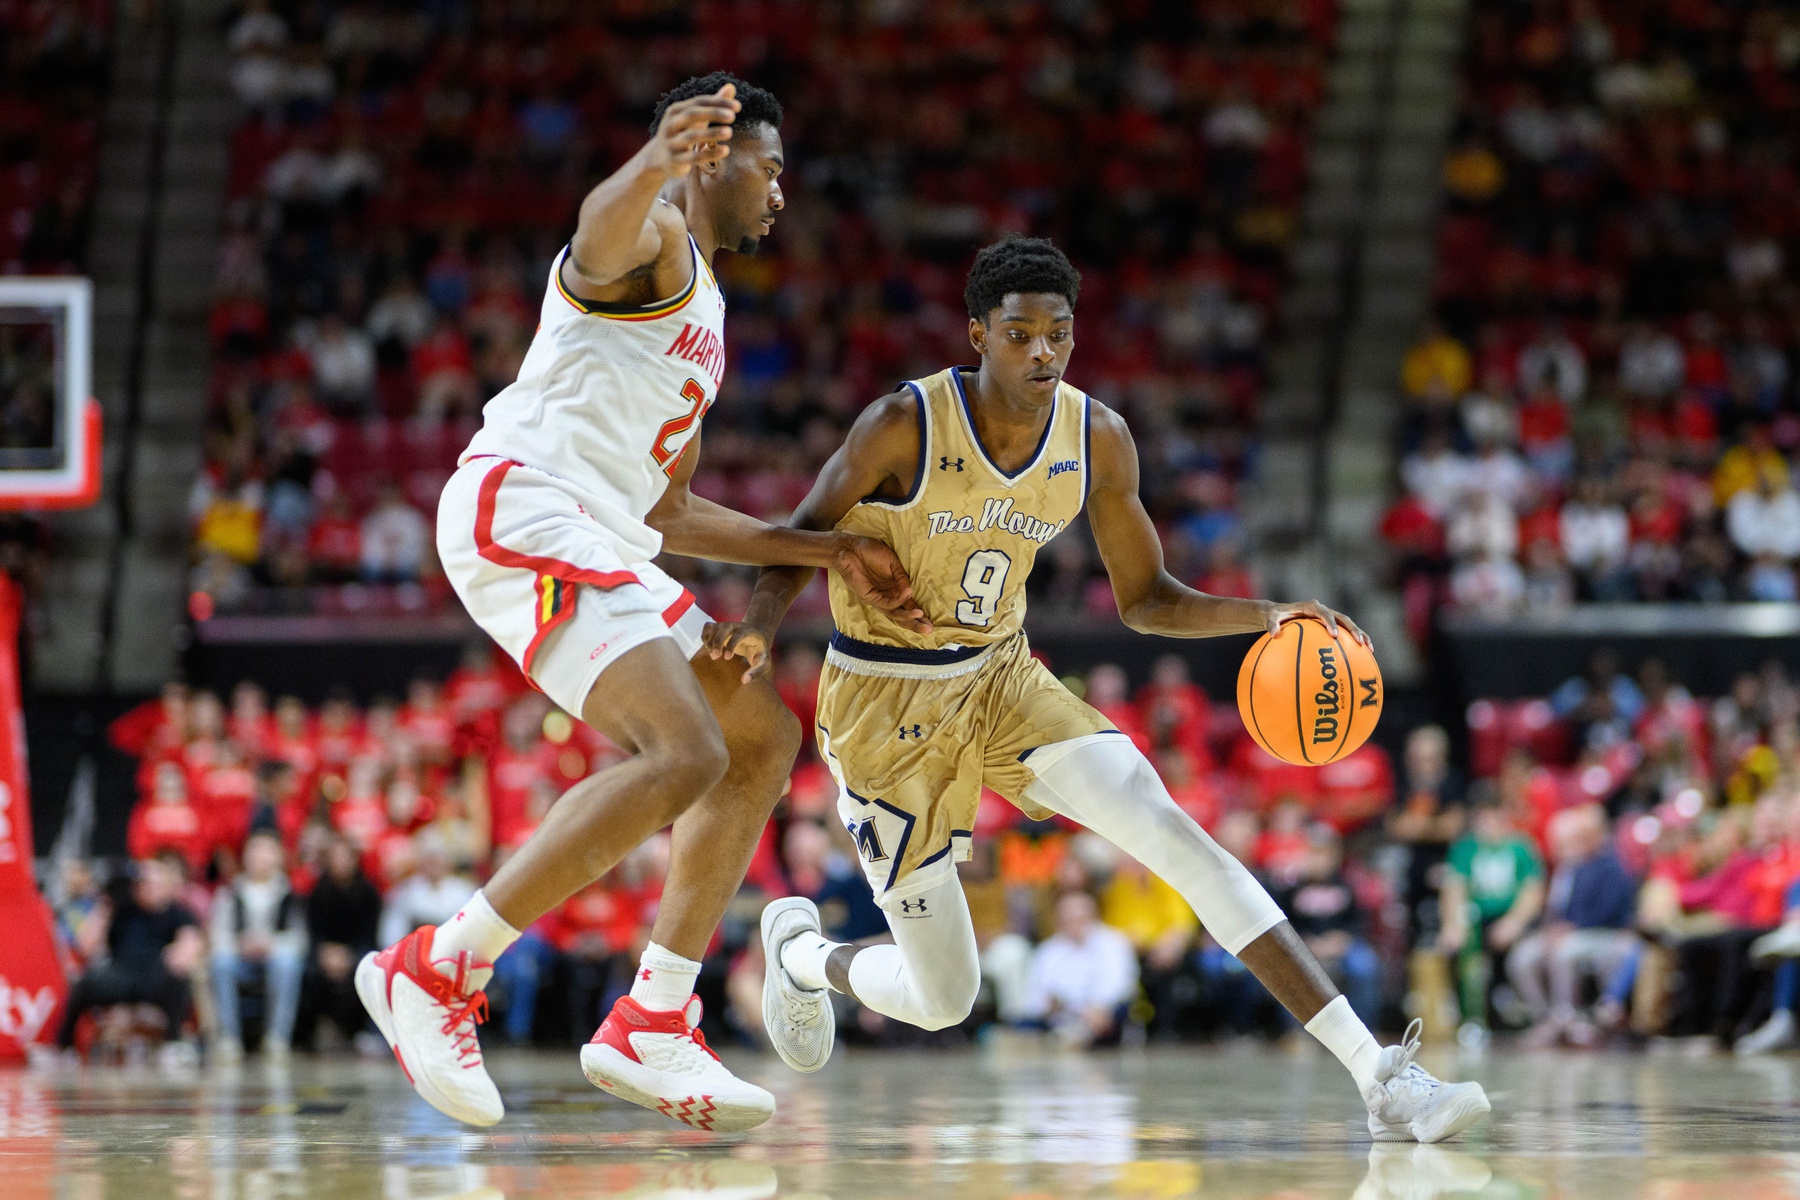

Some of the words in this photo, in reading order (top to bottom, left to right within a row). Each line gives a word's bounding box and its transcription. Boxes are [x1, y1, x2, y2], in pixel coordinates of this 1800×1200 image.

[1047, 460, 1079, 481] MAAC
[928, 510, 974, 539] The
[955, 549, 1012, 627] 9
[1312, 646, 1340, 745] Wilson
[1358, 677, 1379, 710] M
[847, 815, 890, 863] M
